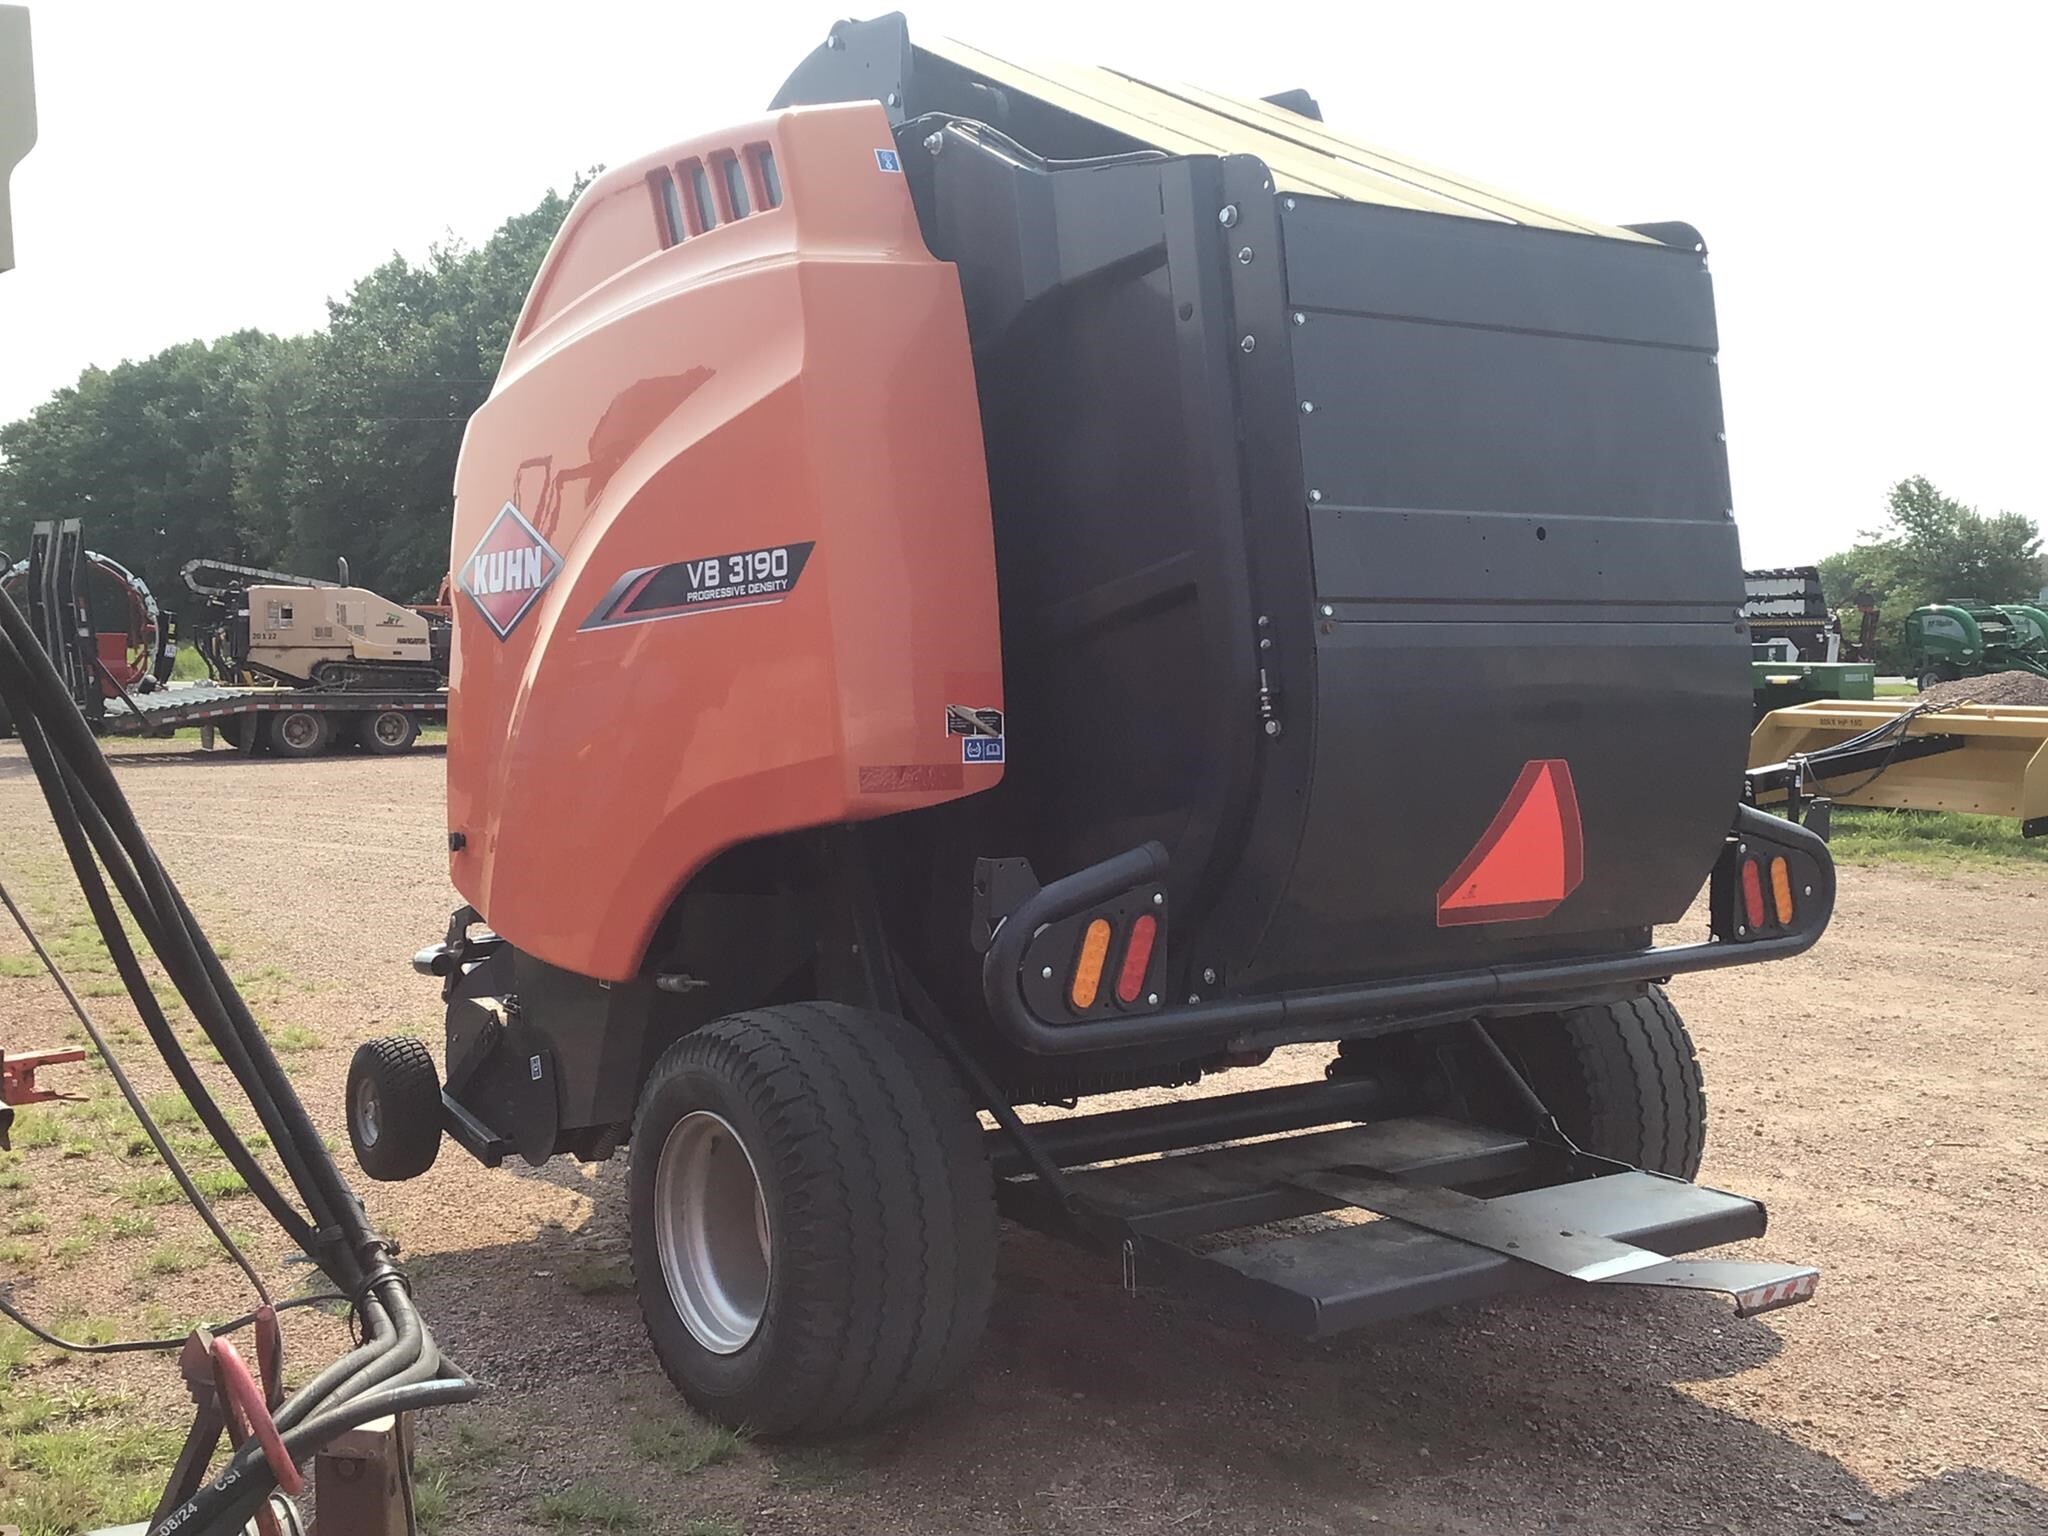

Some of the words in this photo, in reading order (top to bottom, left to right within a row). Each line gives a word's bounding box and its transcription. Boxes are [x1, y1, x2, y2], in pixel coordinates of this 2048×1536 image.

[473, 545, 542, 595] KUHN
[687, 559, 720, 589] VB
[728, 548, 788, 583] 3190
[686, 584, 746, 602] PROGRESSIVE
[747, 578, 788, 595] DENSITY
